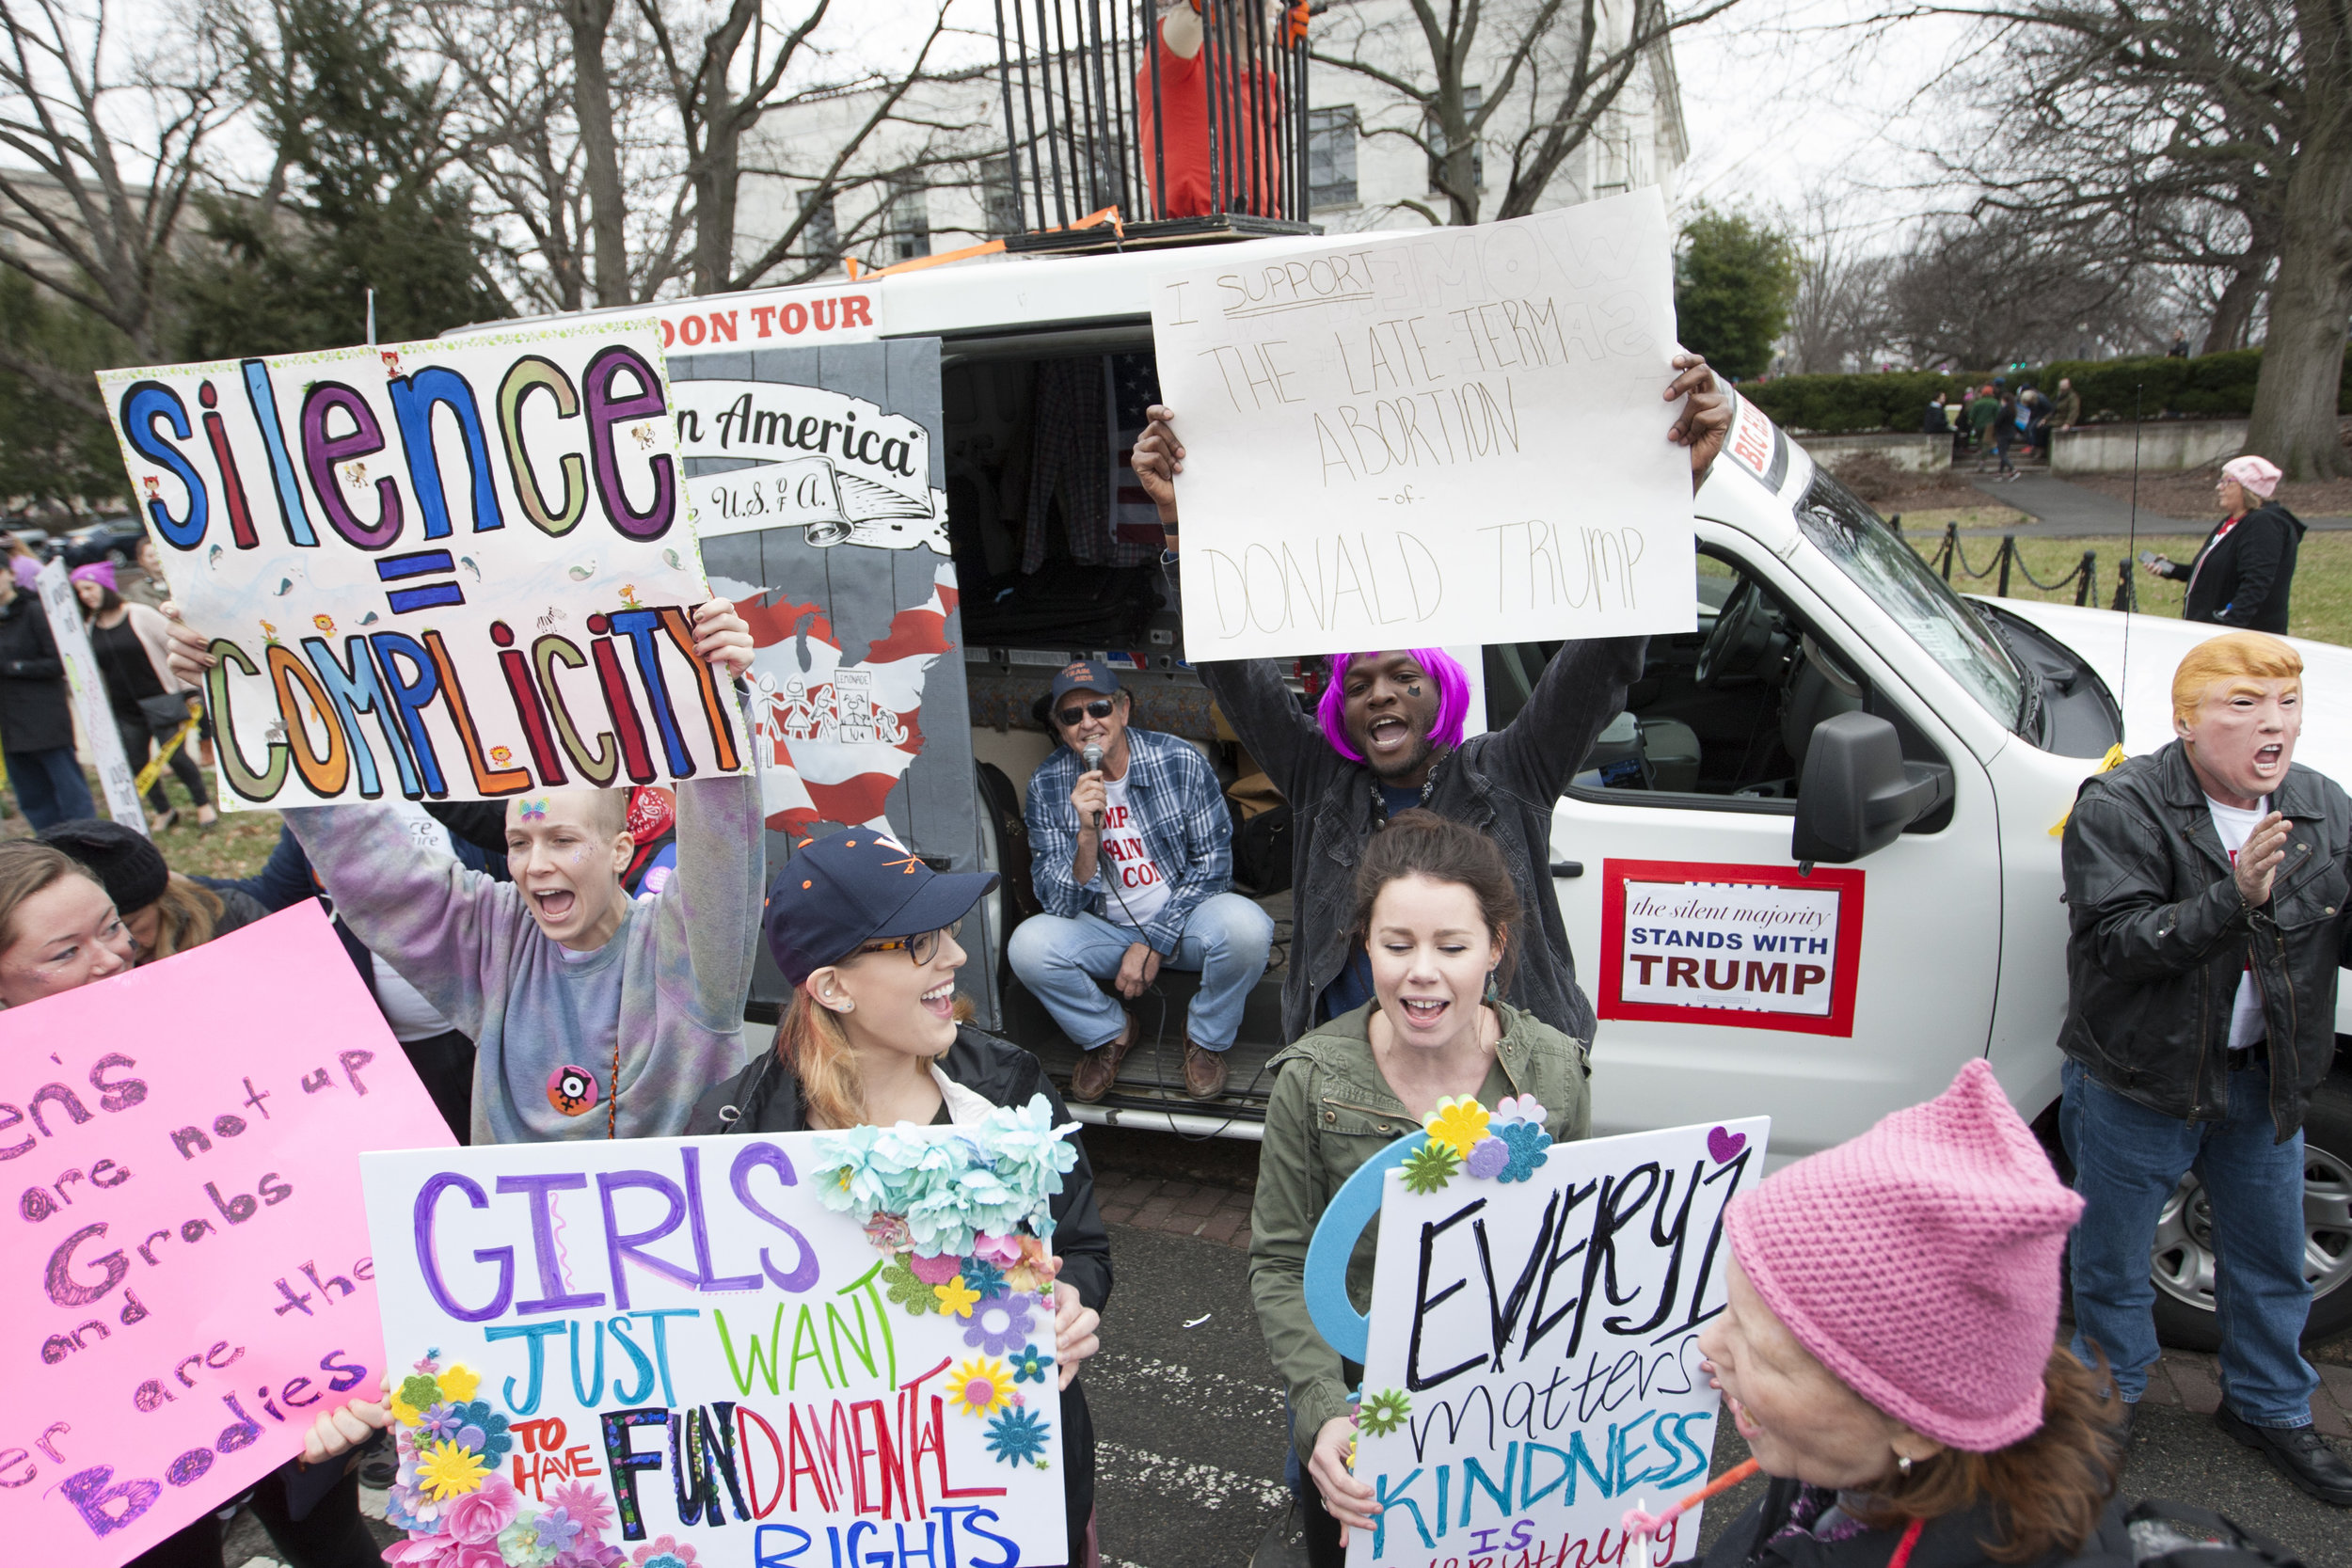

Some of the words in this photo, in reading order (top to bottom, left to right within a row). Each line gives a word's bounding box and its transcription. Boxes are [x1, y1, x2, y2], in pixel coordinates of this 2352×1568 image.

[751, 294, 873, 338] TOUR
[1166, 281, 1199, 326] I
[1216, 250, 1375, 312] SUPPORT
[1197, 340, 1306, 413] THE
[715, 392, 916, 477] America
[1313, 377, 1518, 487] ABORTION
[1201, 531, 1442, 639] DONALD
[1630, 927, 1743, 950] STANDS
[1753, 934, 1829, 955] WITH
[1632, 896, 1666, 917] the
[1669, 899, 1729, 921] silent
[1732, 904, 1832, 932] majority
[1629, 953, 1827, 995] TRUMP
[19, 1158, 135, 1223] are
[169, 1076, 271, 1161] not
[43, 1172, 293, 1308] Grabs
[413, 1141, 821, 1323] GIRLS
[40, 1287, 151, 1365] and
[485, 1308, 700, 1417] JUST
[714, 1259, 898, 1397] WANT
[133, 1339, 246, 1413] are
[43, 1348, 368, 1541] Bodies
[509, 1418, 567, 1454] TO
[513, 1444, 601, 1503] HAVE
[599, 1356, 1009, 1542] FUNDAMENTAL
[1372, 1409, 1712, 1560] KINDNESS
[755, 1505, 1021, 1568] RIGHTS
[1468, 1519, 1536, 1557] IS
